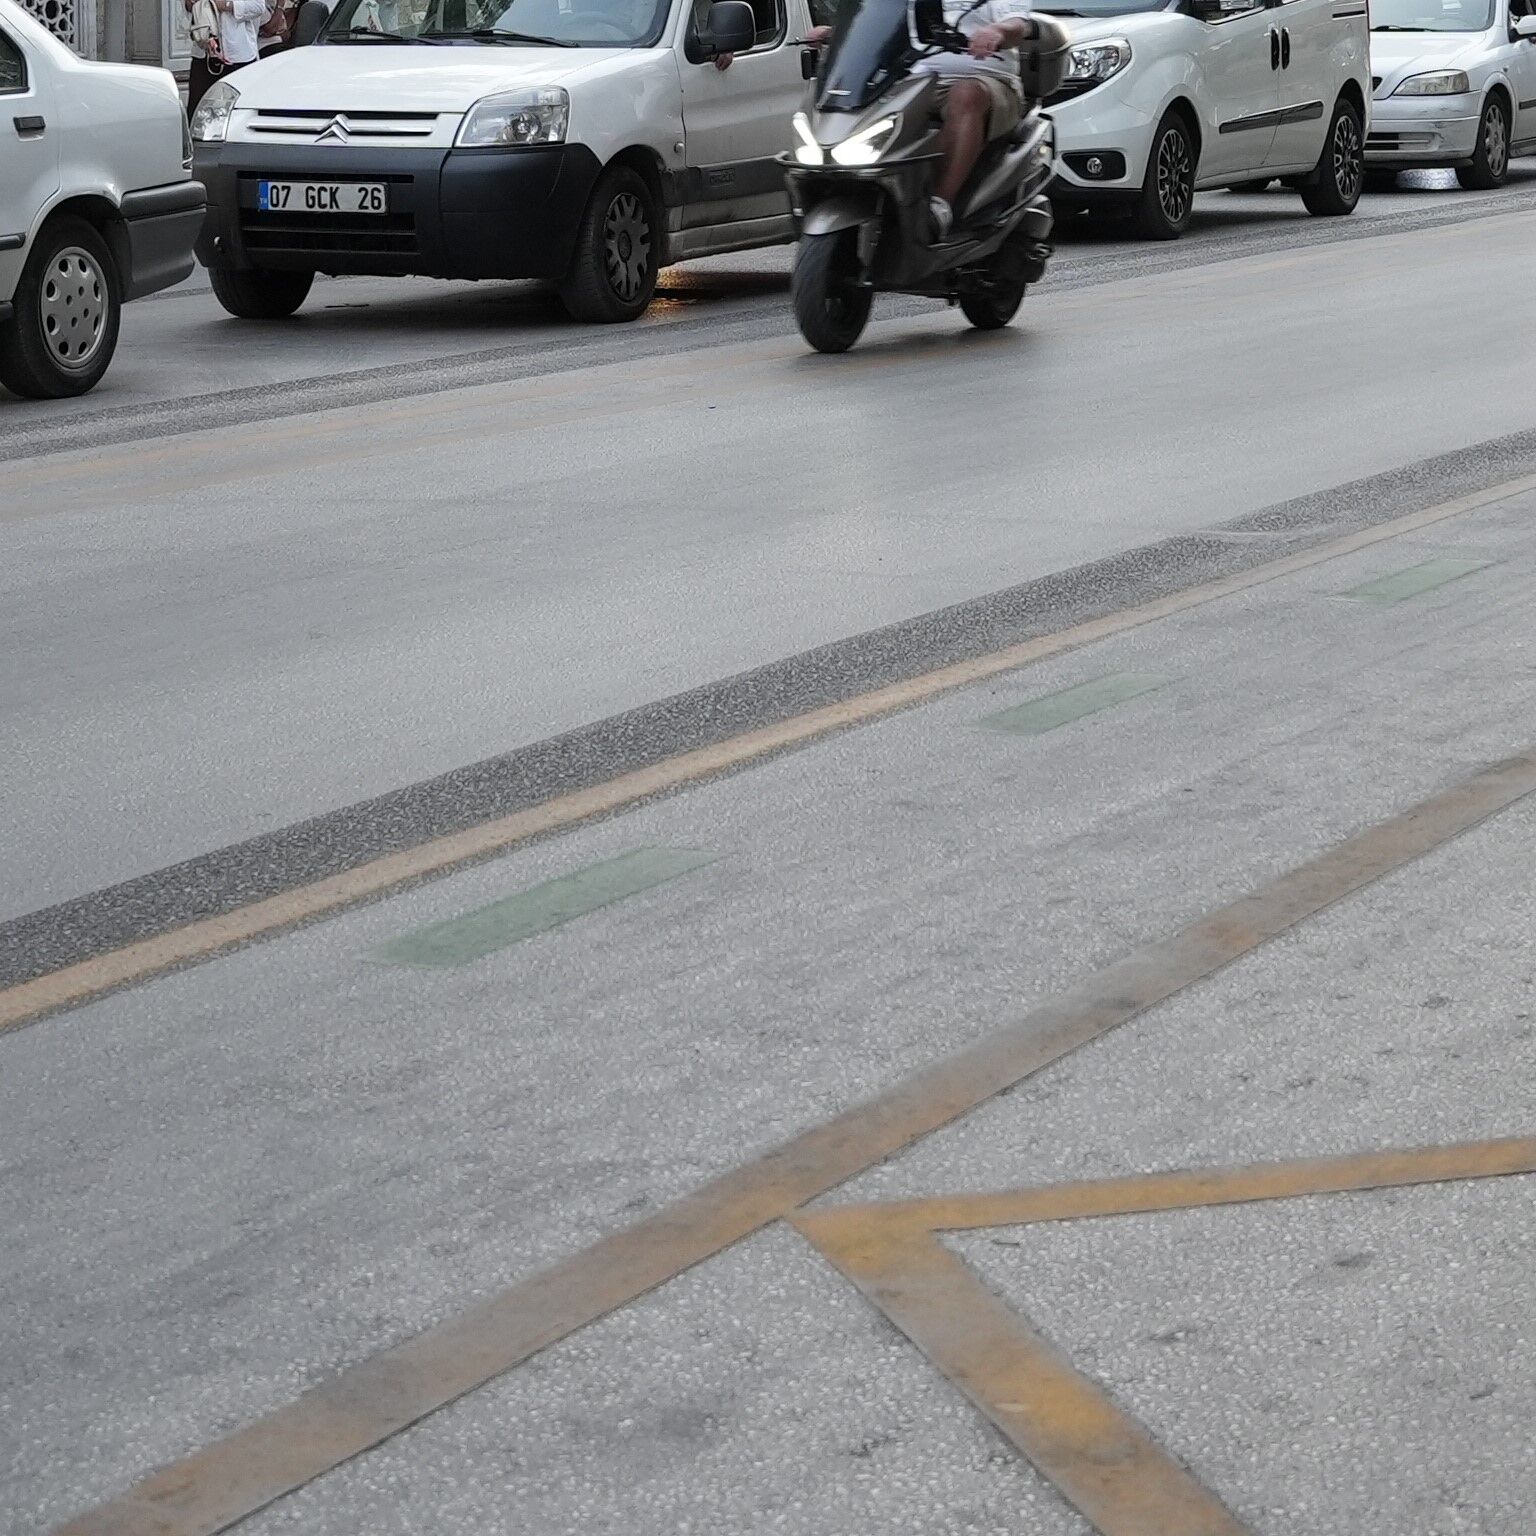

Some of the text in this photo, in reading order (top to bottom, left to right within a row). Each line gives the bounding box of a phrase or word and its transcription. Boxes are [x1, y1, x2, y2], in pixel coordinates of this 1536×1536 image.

[269, 185, 291, 208] 07
[305, 186, 340, 210] GCK
[358, 187, 382, 210] 26
